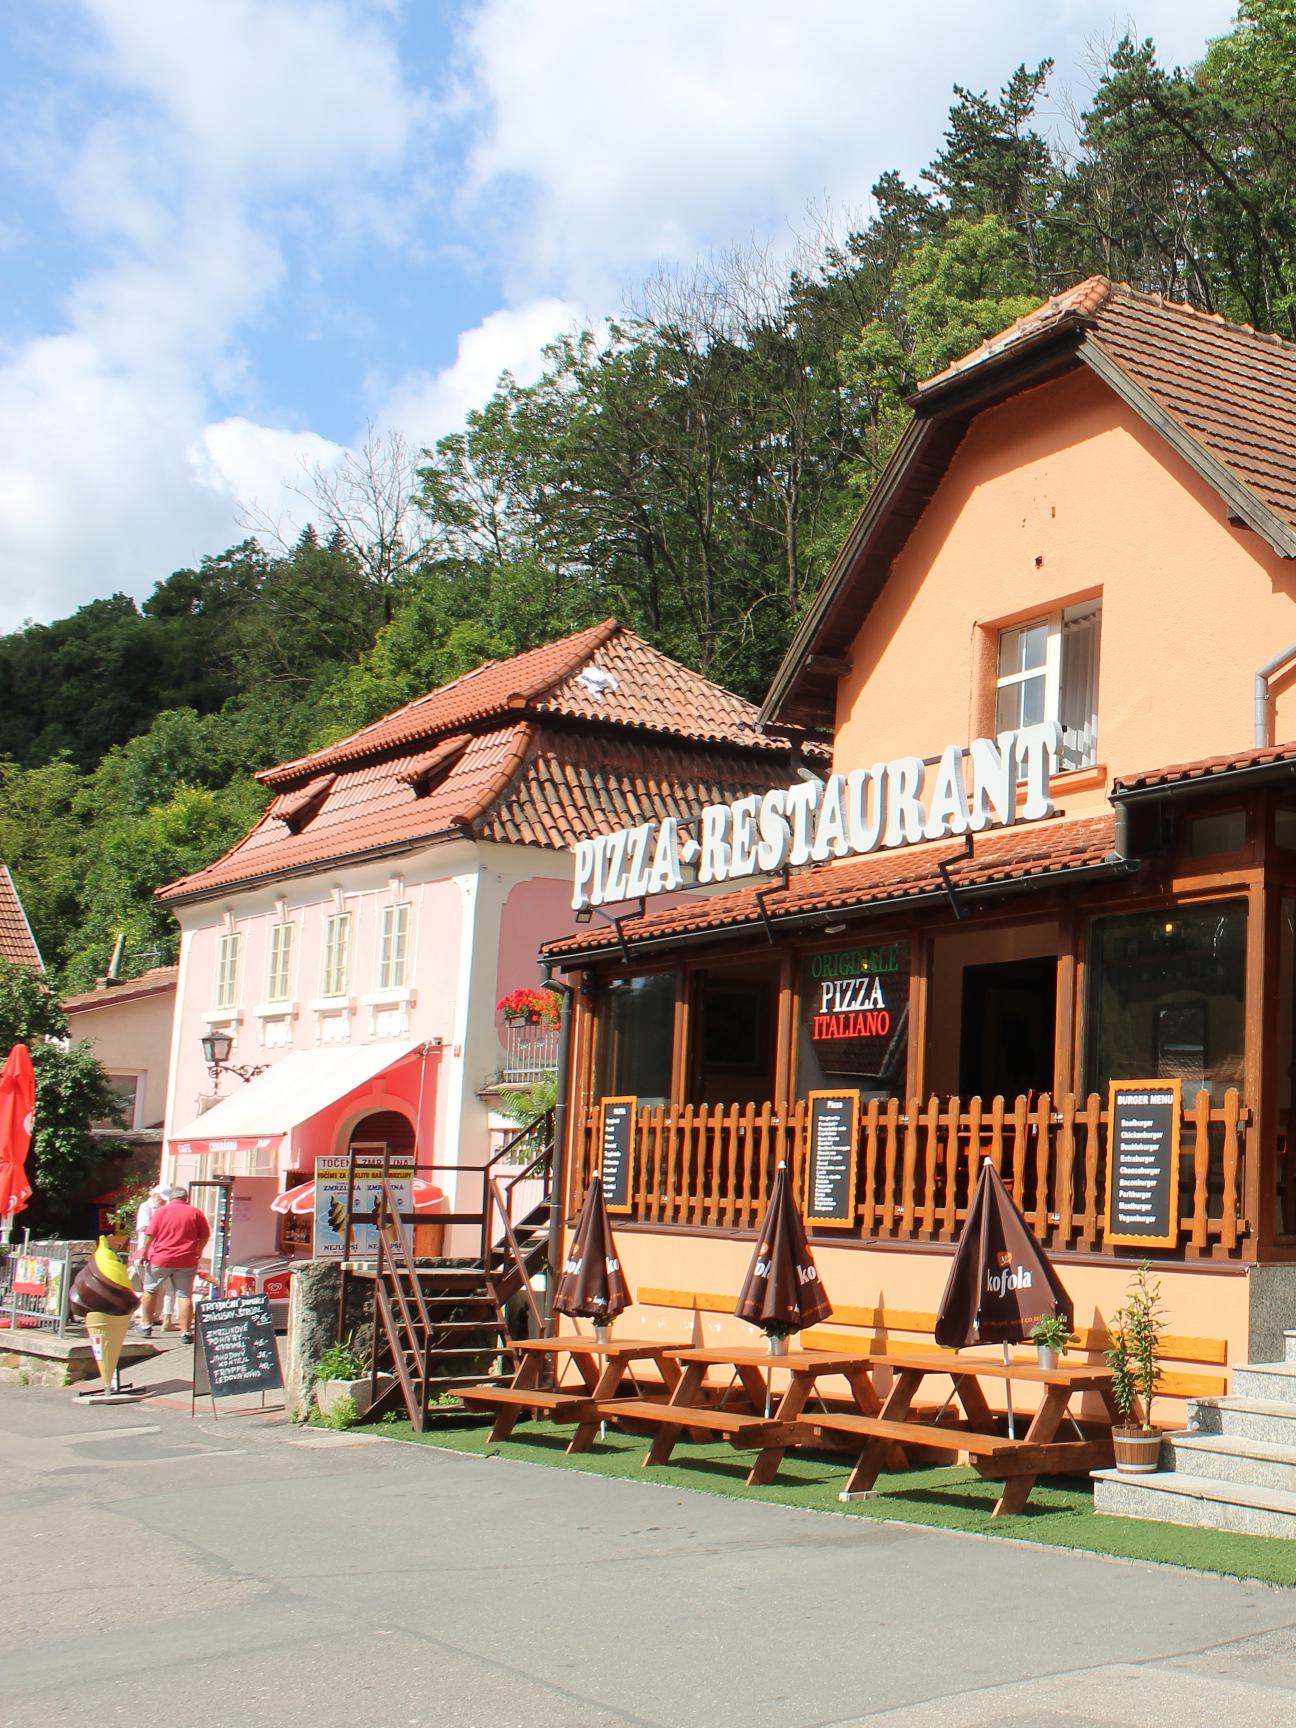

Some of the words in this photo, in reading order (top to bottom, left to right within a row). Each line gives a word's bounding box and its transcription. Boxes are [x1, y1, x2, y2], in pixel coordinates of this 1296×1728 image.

[571, 817, 683, 911] PIZZA
[698, 720, 1064, 883] RESTAURANT
[820, 977, 885, 1013] PIZZA
[813, 1011, 890, 1040] ITALIANO
[1117, 1095, 1149, 1105] BURGER
[1150, 1094, 1174, 1105] MENU
[1121, 1131, 1163, 1140] Chickenburger
[1120, 1155, 1155, 1164] Extraburger
[1120, 1166, 1160, 1176] Cheeseburger
[1119, 1179, 1157, 1188] Baconburger
[986, 1265, 1032, 1298] kofola
